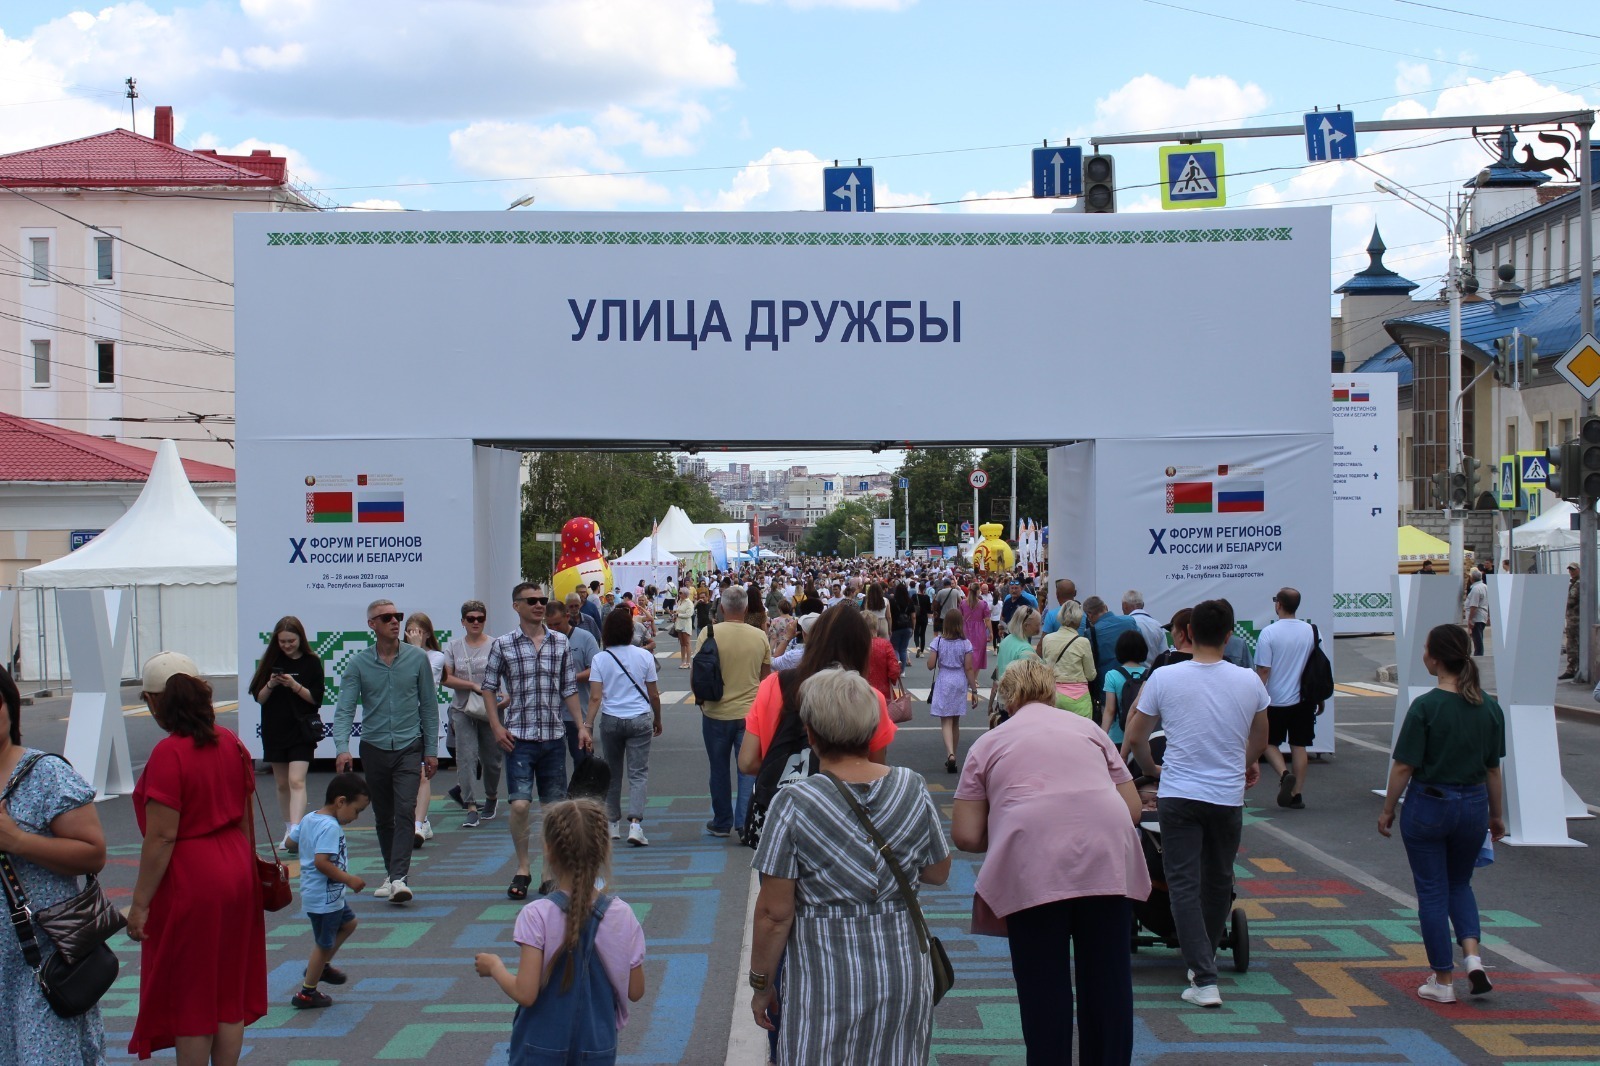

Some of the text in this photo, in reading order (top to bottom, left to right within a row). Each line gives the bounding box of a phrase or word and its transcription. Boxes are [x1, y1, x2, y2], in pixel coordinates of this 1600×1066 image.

[567, 299, 961, 351] УЛИЦА ДРУЖБЫ
[973, 475, 984, 483] 40
[1170, 526, 1281, 539] ФОРУМ РЕГИОНОВ
[310, 536, 422, 548] ФОРУМ РЕГИОНОВ
[1170, 542, 1282, 554] РОССИИ И БЕЛАРУСИ
[310, 553, 422, 563] РОССИИ И БЕЛАРУСИ
